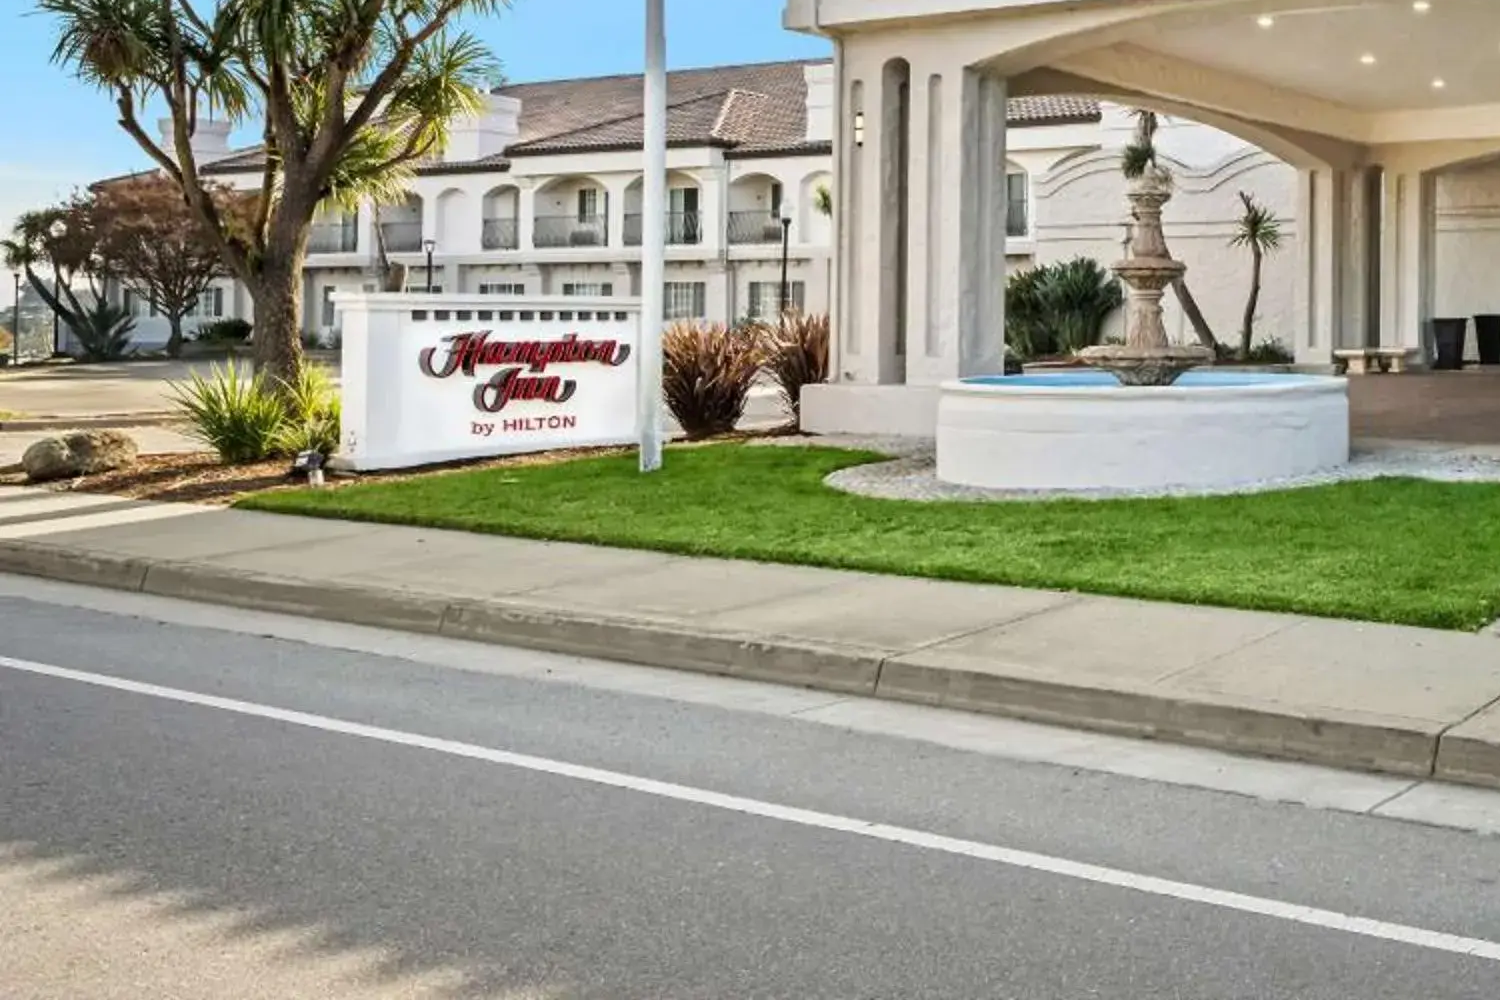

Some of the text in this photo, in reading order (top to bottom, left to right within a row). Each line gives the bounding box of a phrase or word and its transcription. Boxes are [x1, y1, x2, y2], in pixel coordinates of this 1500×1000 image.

[418, 330, 631, 378] Hampton
[472, 367, 577, 412] Inn
[471, 415, 576, 436] by HILTON
